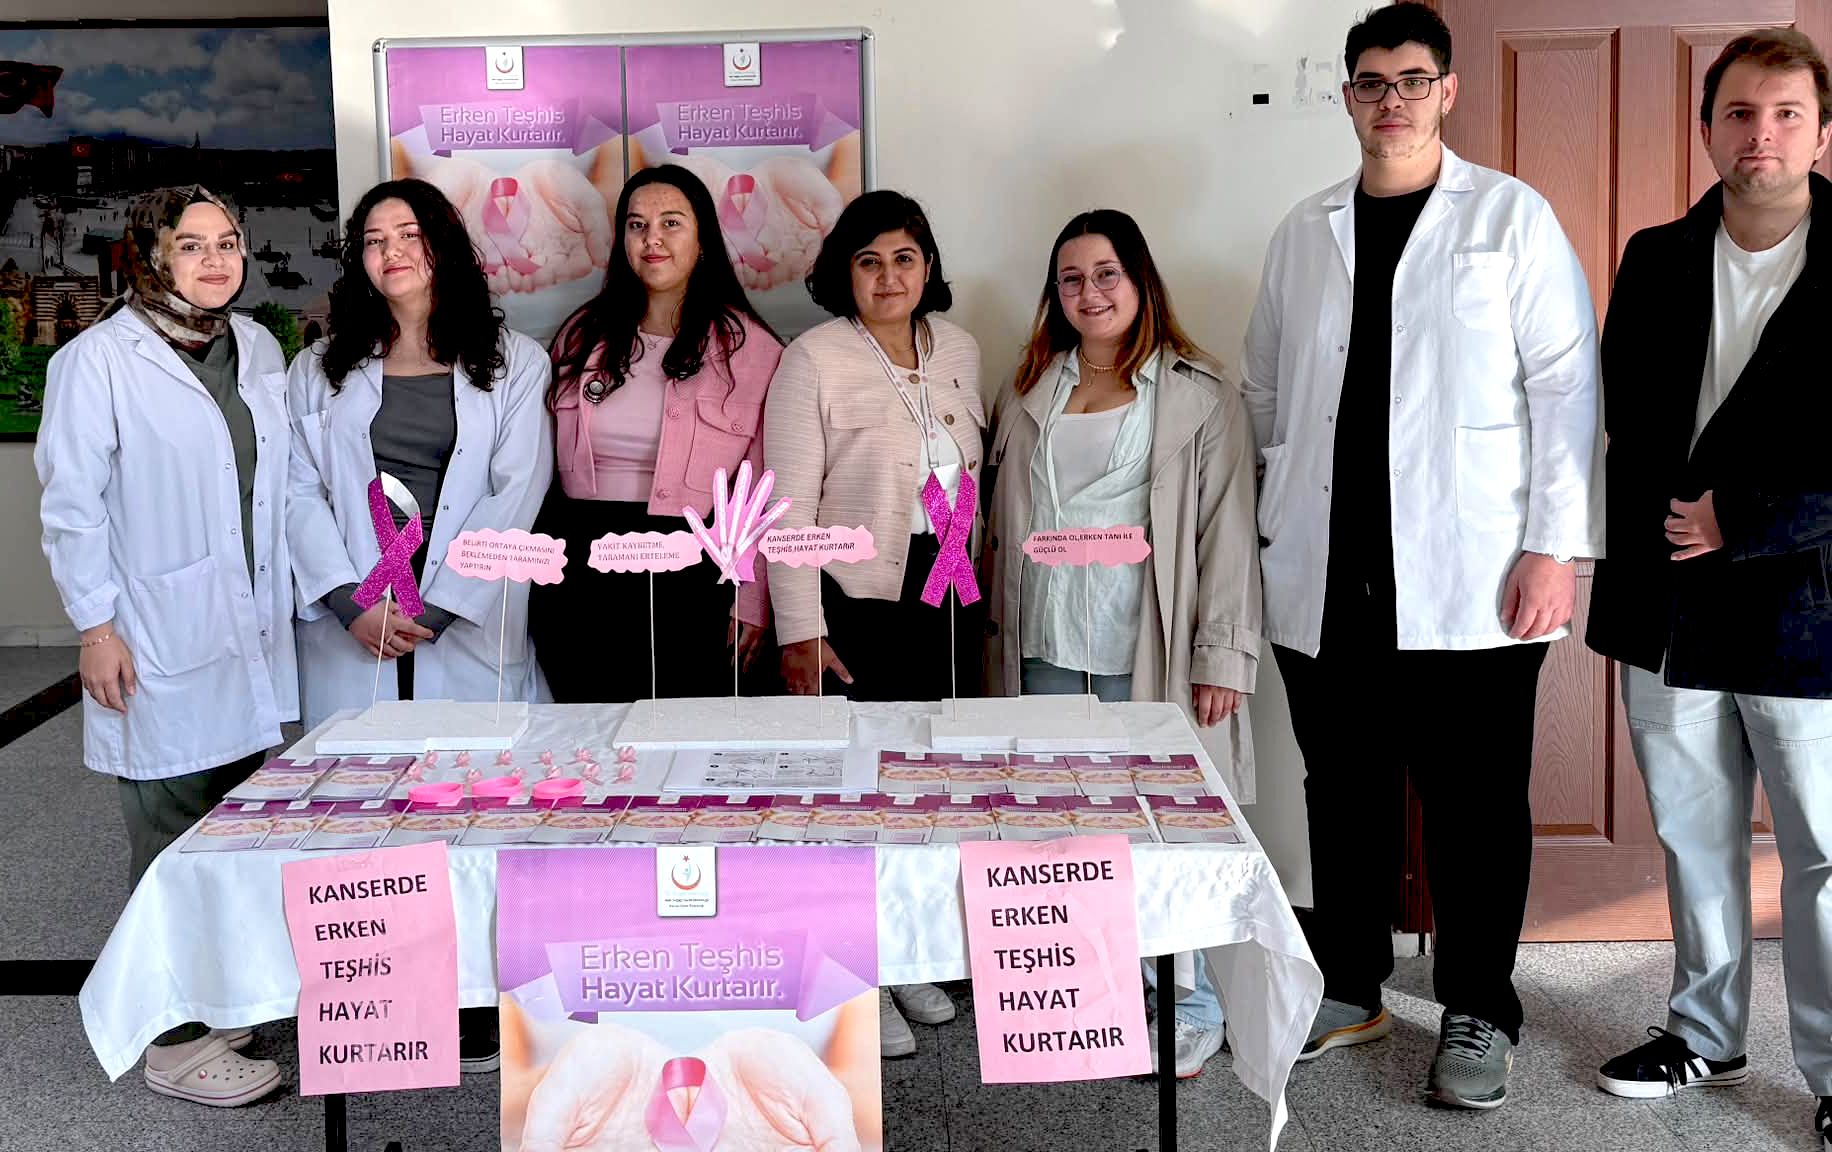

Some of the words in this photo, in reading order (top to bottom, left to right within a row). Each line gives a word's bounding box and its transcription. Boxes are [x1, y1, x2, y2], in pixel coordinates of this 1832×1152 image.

[440, 105, 496, 123] Erken
[502, 105, 565, 127] Teşhis
[679, 103, 735, 121] Erken
[739, 103, 802, 125] Teşhis
[441, 127, 493, 145] Hayat
[679, 125, 729, 143] Hayat
[767, 534, 805, 542] KANSERDE
[806, 532, 831, 541] ERKEN
[794, 543, 818, 552] HAYAT
[819, 542, 855, 552] KURTARIR
[987, 860, 1115, 887] KANSERDE
[309, 874, 428, 904] KANSERDE
[991, 905, 1068, 927] ERKEN
[315, 918, 386, 941] ERKEN
[320, 953, 392, 983] TEŞHİS
[581, 944, 671, 970] Erken
[680, 942, 782, 974] Teşhis
[994, 943, 1076, 973] TEŞHİS
[581, 976, 665, 1005] Hayat
[672, 974, 783, 999] Kurtarır.
[999, 988, 1080, 1011] HAYAT
[319, 999, 393, 1022] HAYAT
[1003, 1026, 1125, 1053] KURTARIR
[319, 1041, 429, 1065] KURTARIR
